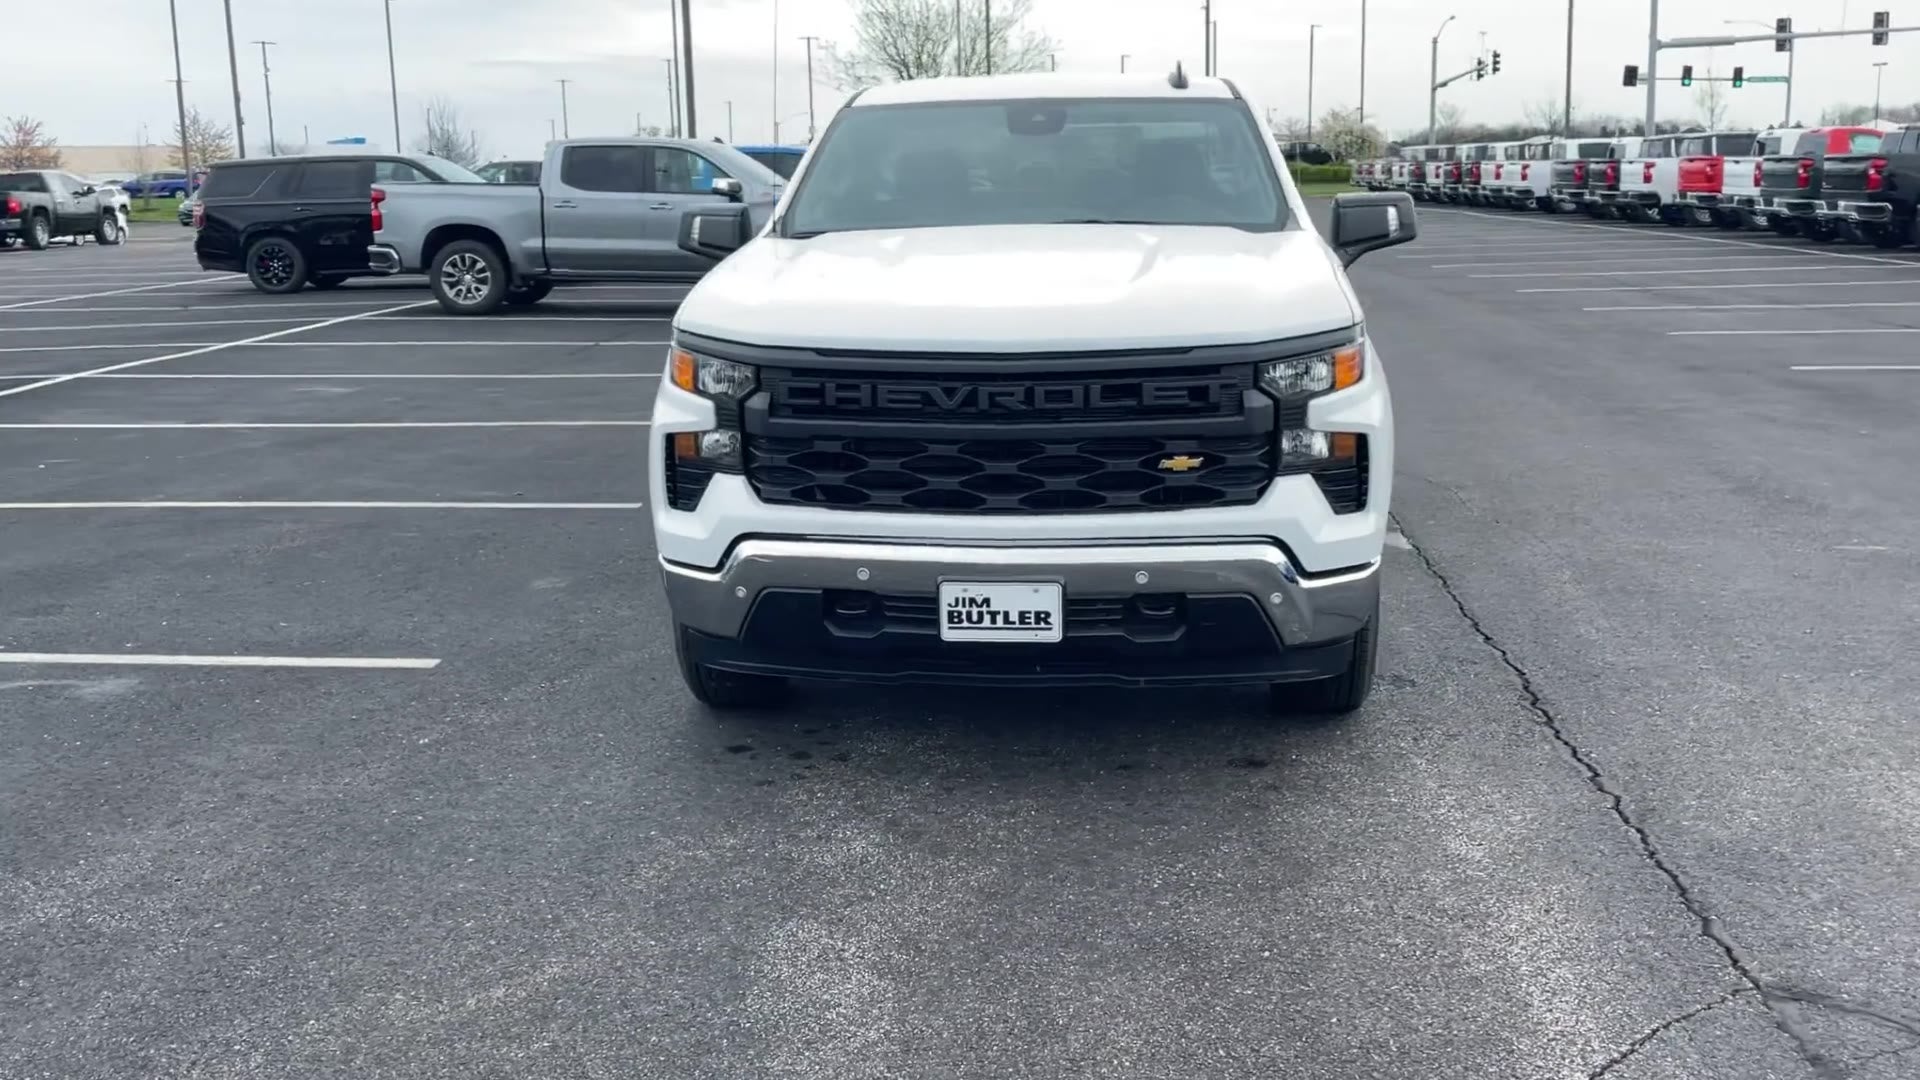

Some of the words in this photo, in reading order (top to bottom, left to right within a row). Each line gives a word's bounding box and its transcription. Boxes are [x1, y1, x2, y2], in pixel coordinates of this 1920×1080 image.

[777, 379, 1237, 409] CHEVROLET
[947, 596, 991, 609] JIM
[947, 610, 1053, 626] BUTLER
